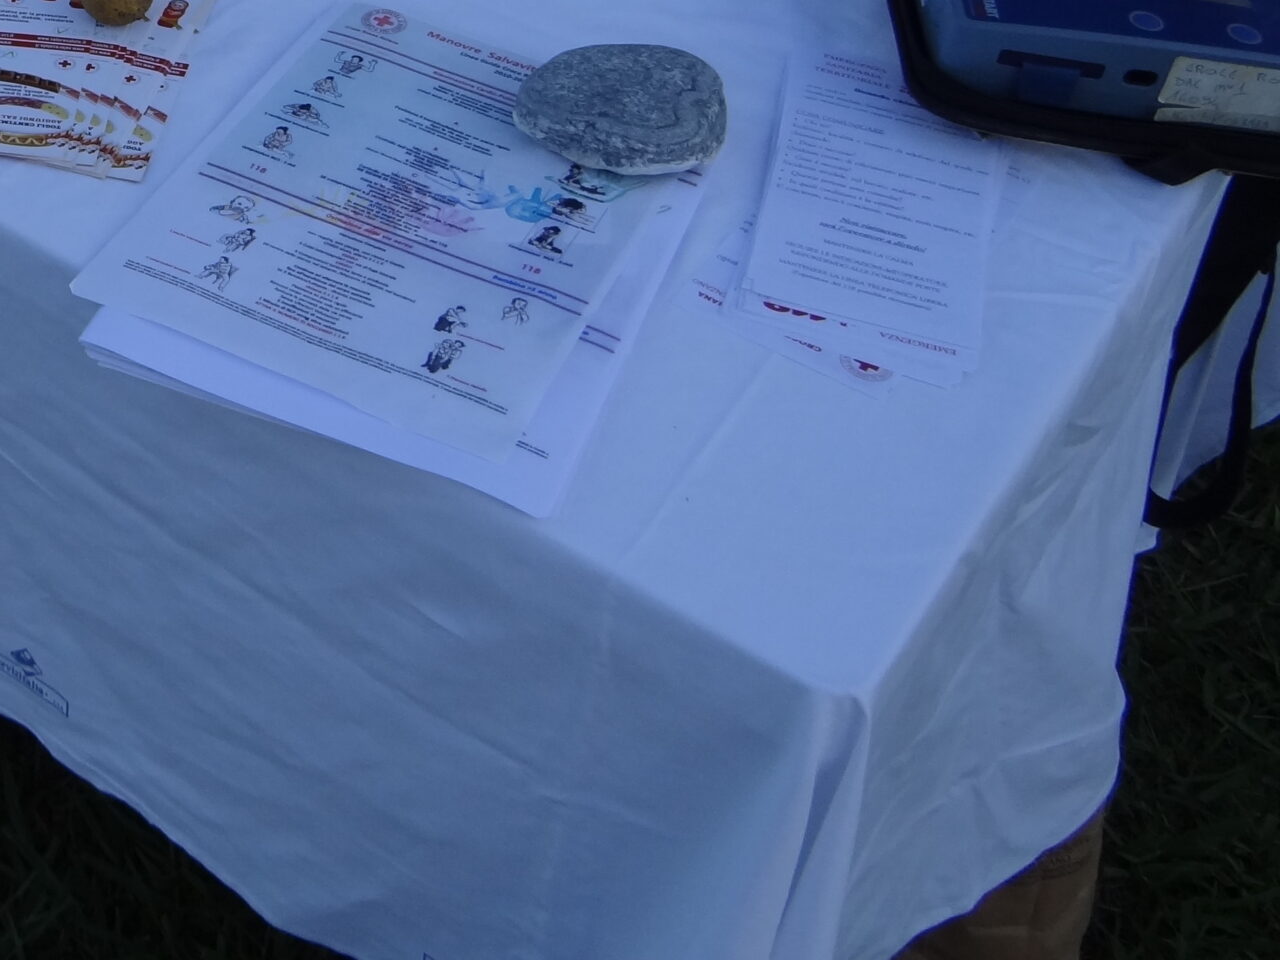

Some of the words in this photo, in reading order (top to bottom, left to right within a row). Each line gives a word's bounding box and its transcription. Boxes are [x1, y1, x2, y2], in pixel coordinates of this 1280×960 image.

[426, 30, 482, 55] Manovre
[487, 51, 538, 73] Salvavit
[879, 331, 957, 357] EMERGENZA
